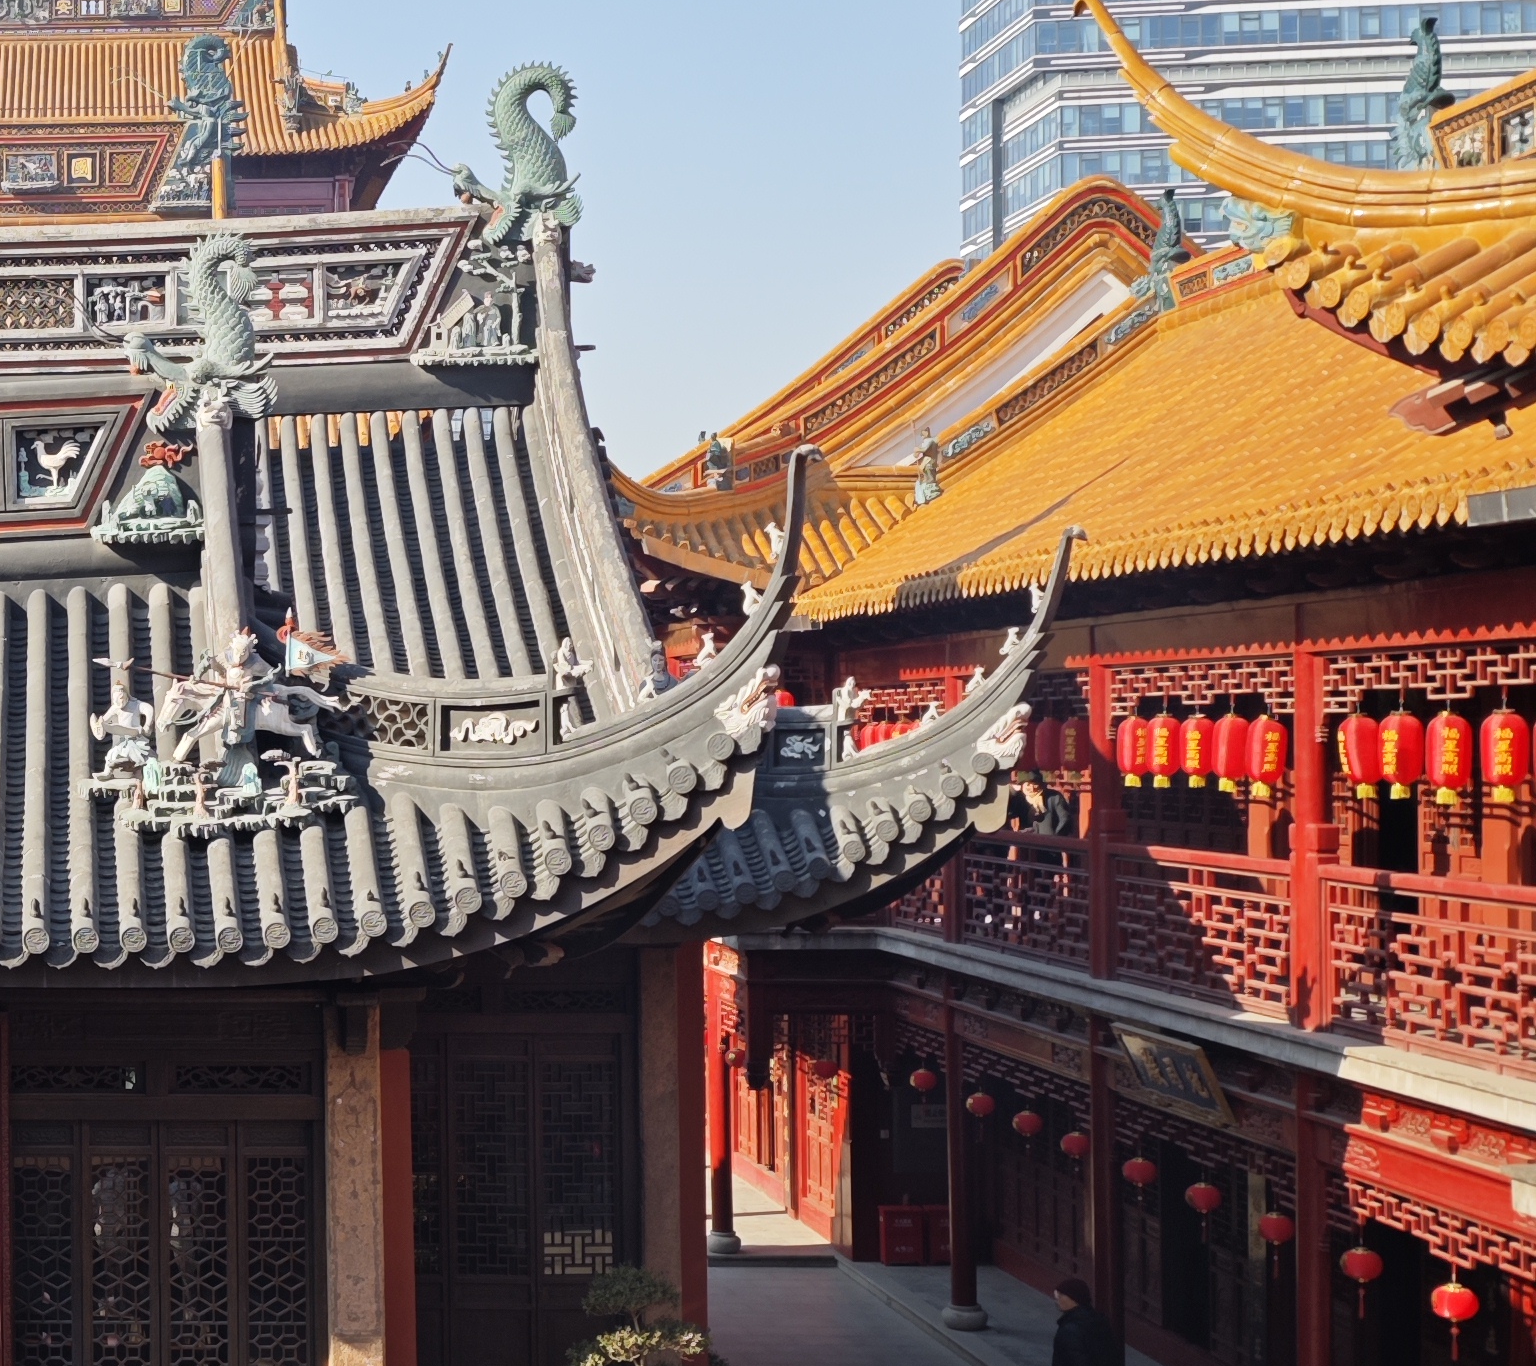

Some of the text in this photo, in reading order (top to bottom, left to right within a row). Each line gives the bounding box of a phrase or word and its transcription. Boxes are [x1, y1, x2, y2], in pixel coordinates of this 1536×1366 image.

[1441, 726, 1460, 776] 福星高照
[1493, 727, 1514, 776] 福星高照
